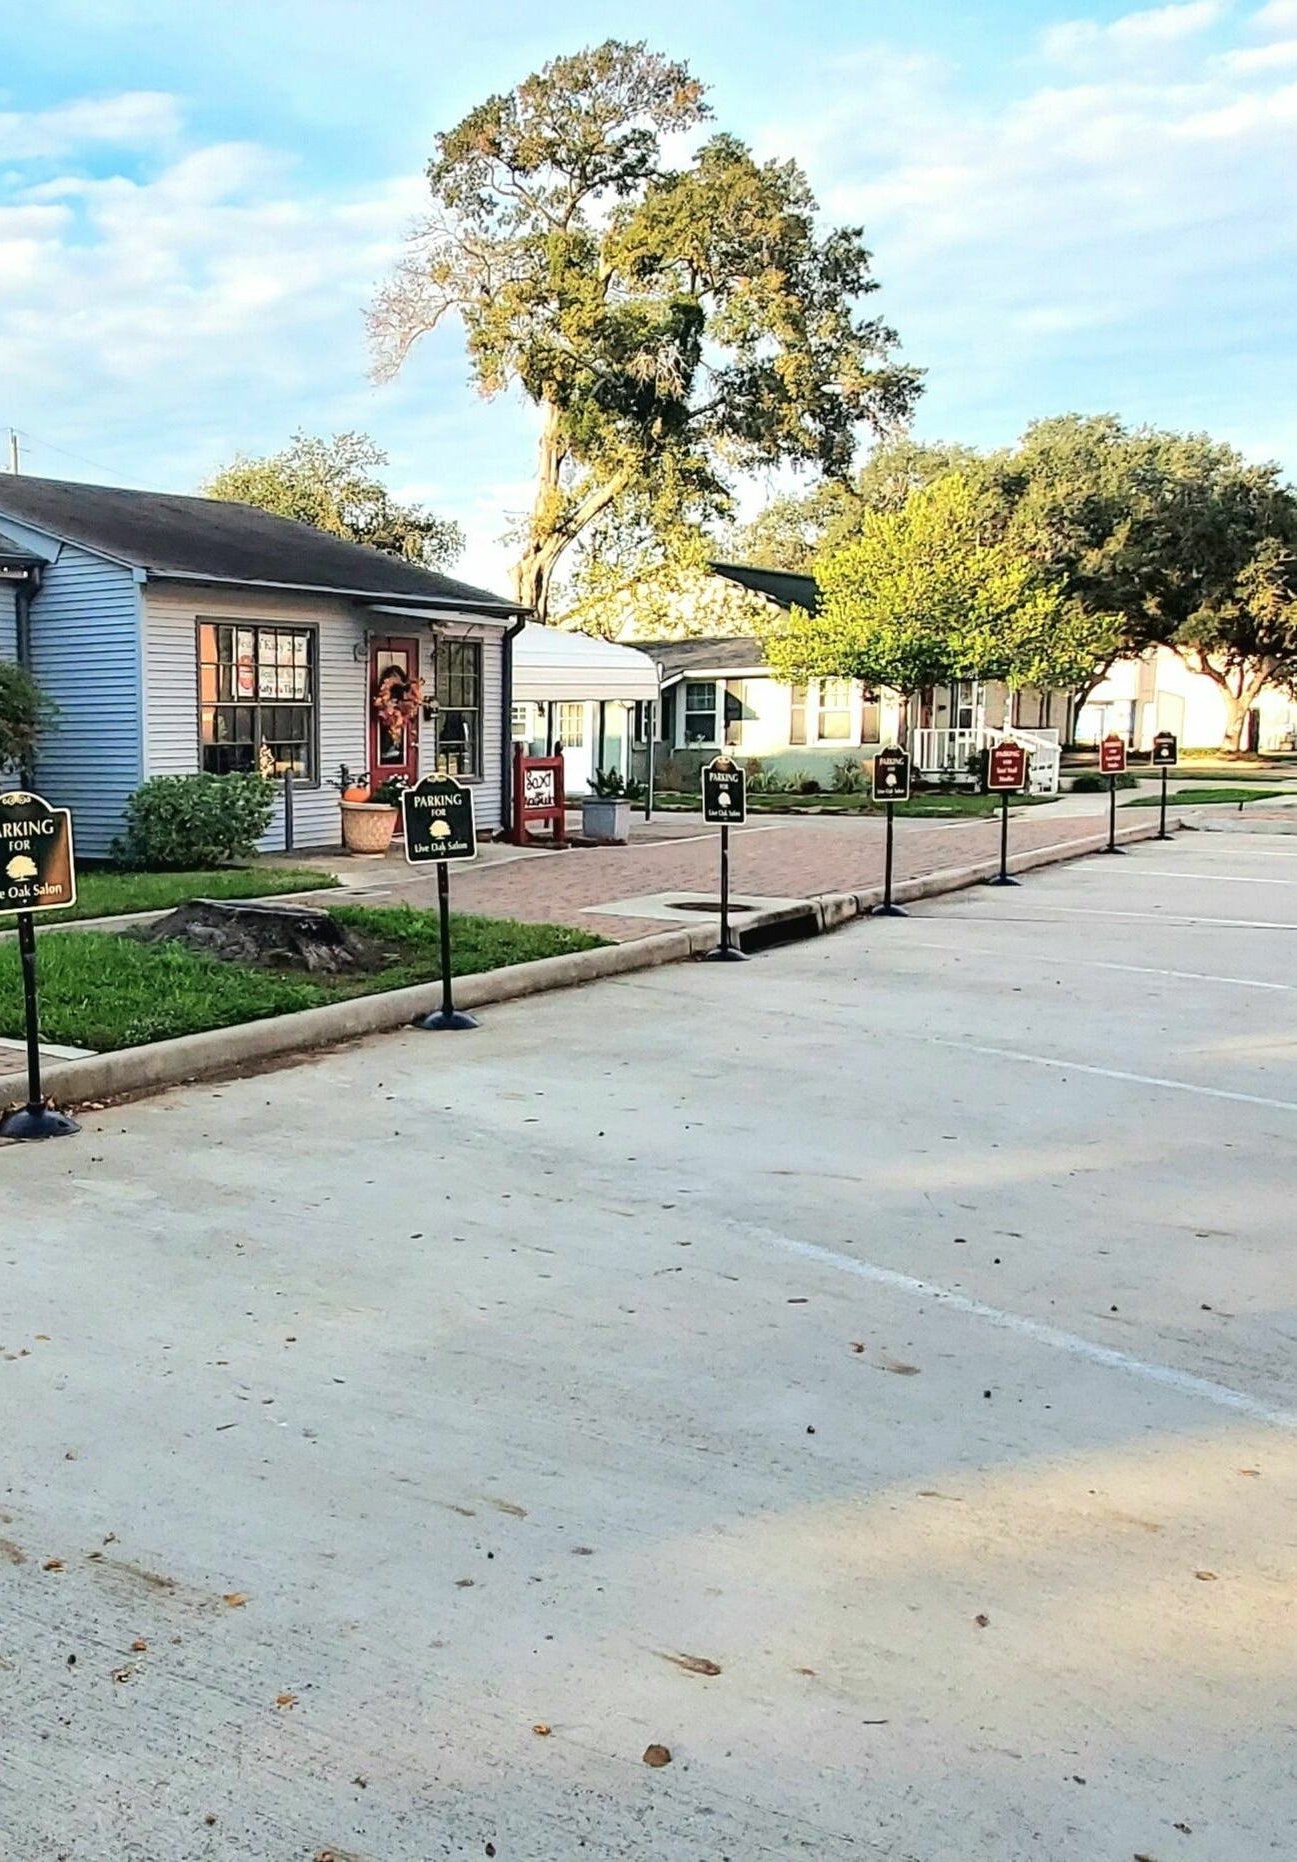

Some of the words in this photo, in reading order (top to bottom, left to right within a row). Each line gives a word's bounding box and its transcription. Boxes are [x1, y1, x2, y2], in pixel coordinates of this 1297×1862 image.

[709, 772, 739, 783] PARKING
[414, 793, 462, 808] PARKING
[431, 808, 447, 817] FOR
[9, 840, 31, 852] FOR
[414, 843, 430, 854] Live
[431, 841, 446, 852] Oak
[447, 840, 468, 851] Salon
[8, 884, 32, 899] Oak
[33, 882, 63, 896] Salon
